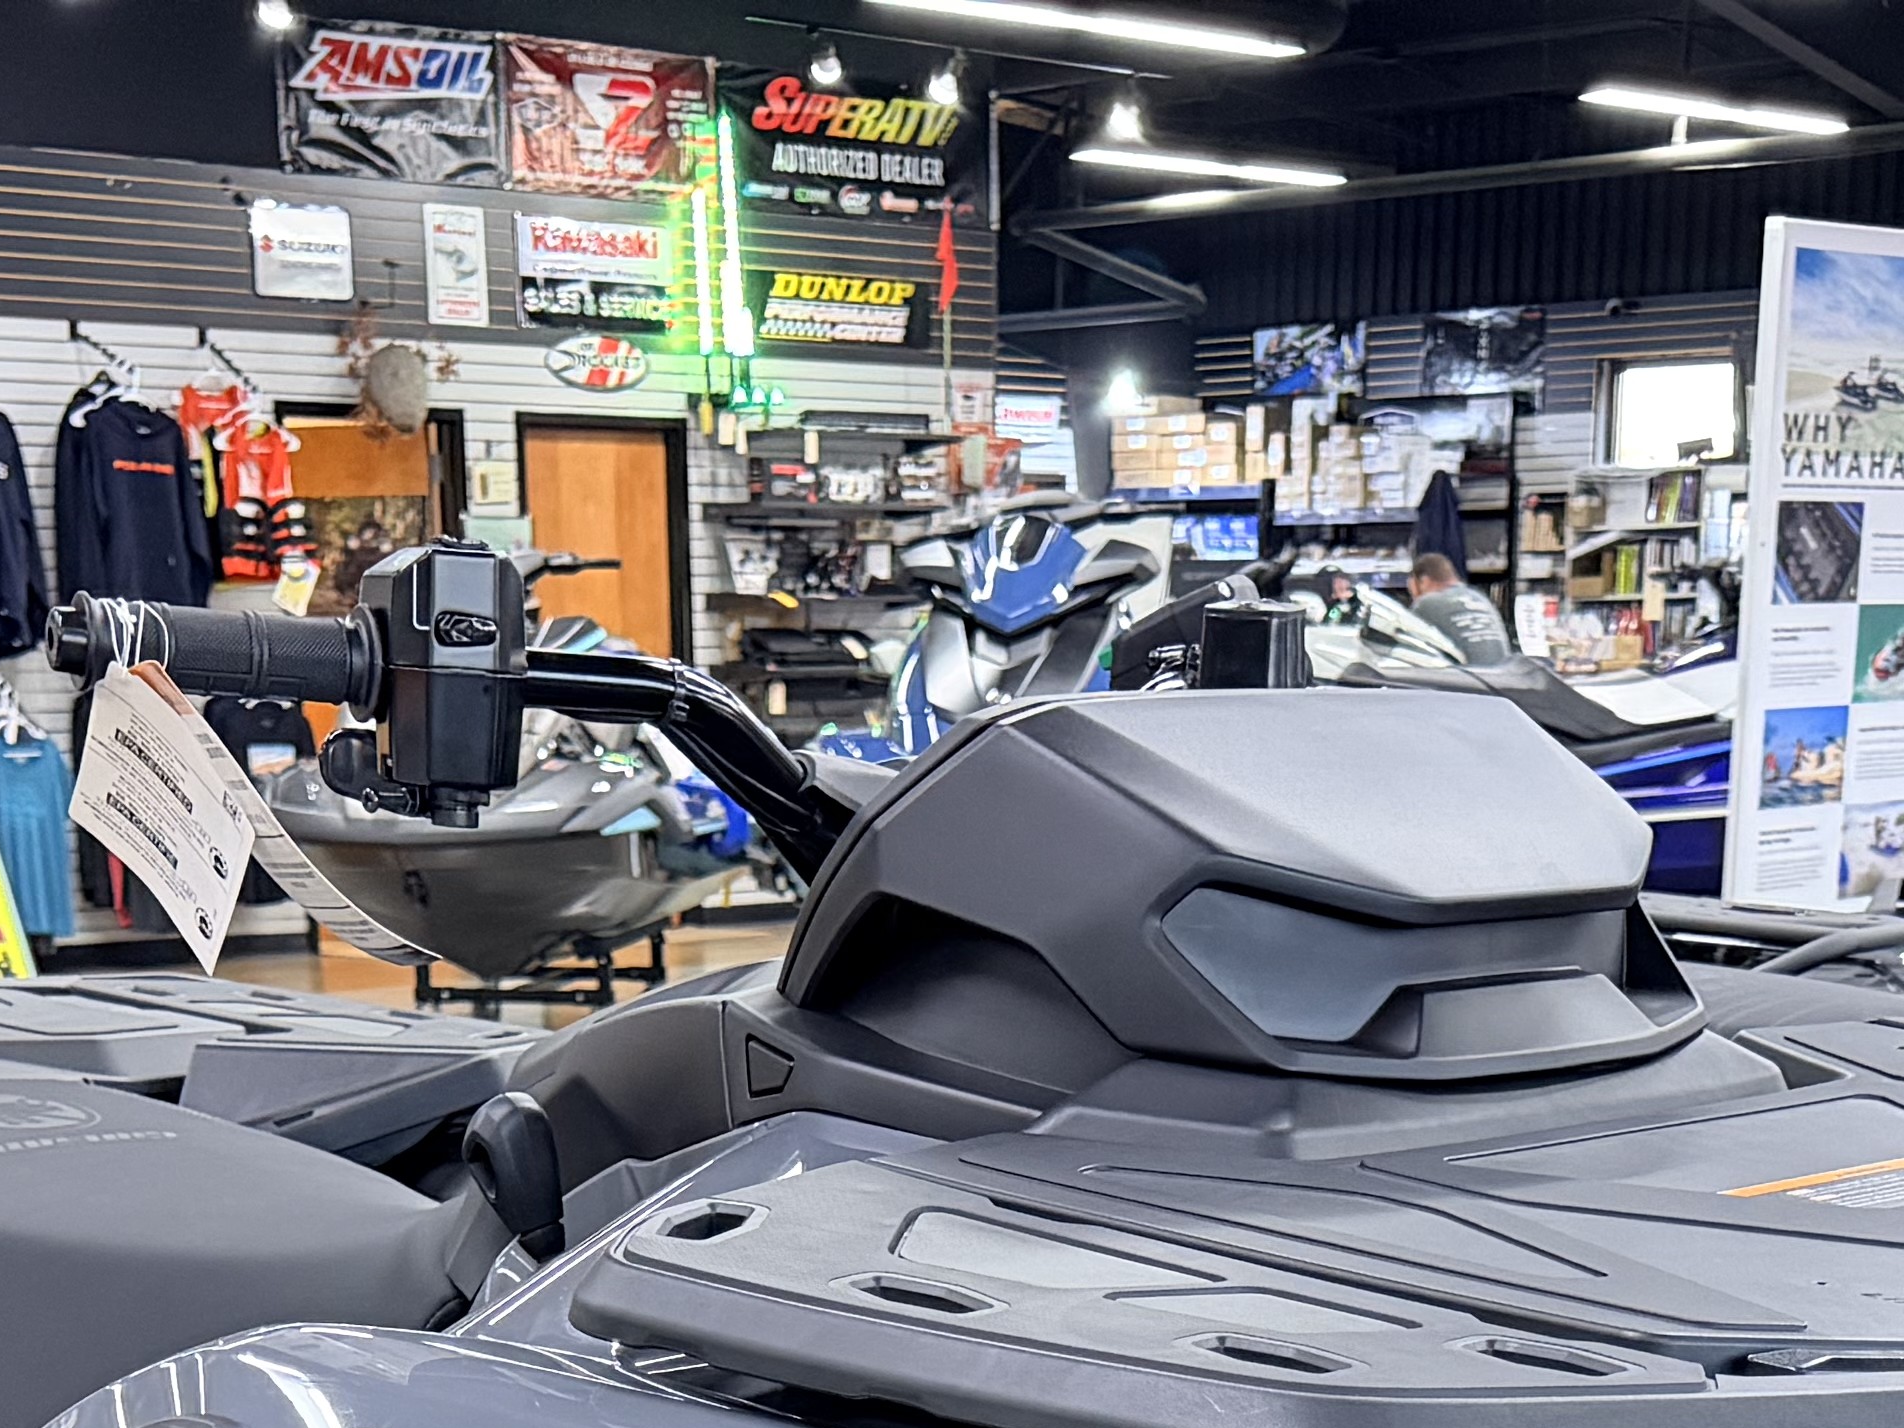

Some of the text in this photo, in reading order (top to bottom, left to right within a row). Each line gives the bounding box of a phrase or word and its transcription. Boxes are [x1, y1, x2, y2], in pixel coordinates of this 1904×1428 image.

[296, 36, 493, 93] AMSOIL
[772, 142, 945, 186] AUTHORIZED DEALER
[769, 273, 916, 305] DUNLOP
[1783, 412, 1853, 443] WHY
